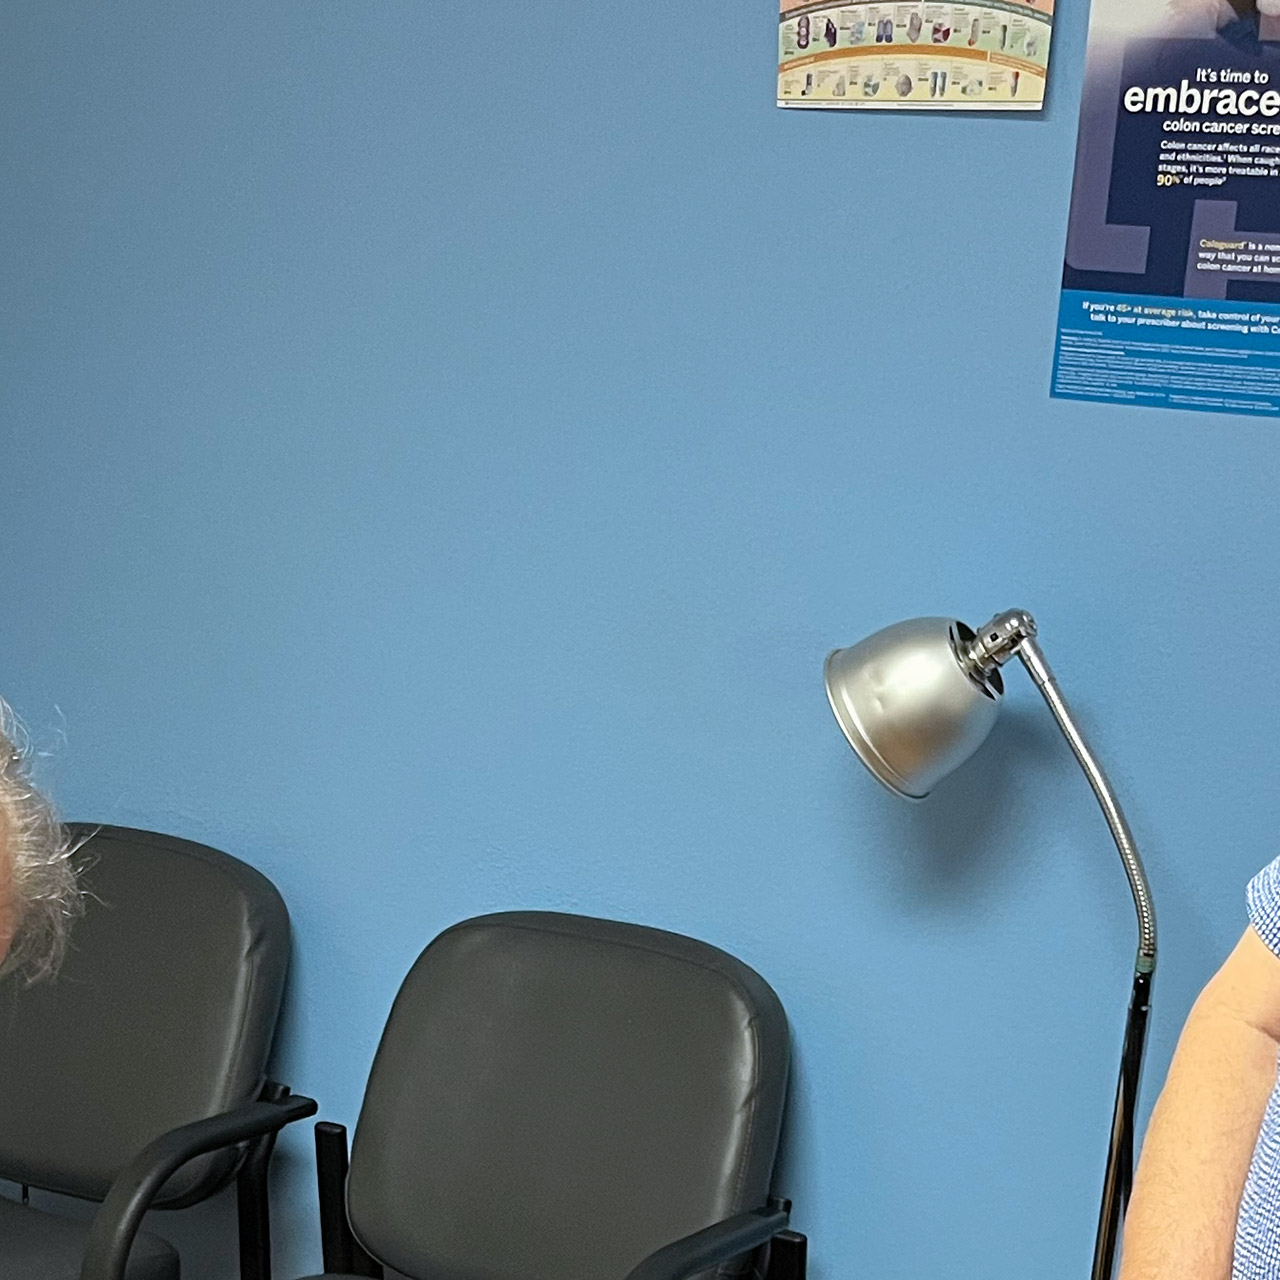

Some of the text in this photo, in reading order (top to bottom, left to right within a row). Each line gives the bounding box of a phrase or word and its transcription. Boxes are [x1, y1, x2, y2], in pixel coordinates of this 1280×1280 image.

[1196, 68, 1269, 83] It's time to
[1123, 79, 1280, 116] embrace
[1162, 118, 1200, 132] colon
[1202, 121, 1249, 135] cancer
[1160, 140, 1186, 150] Colon
[1186, 142, 1216, 151] cancer
[1217, 142, 1248, 153] affects
[1249, 144, 1260, 153] all
[1159, 152, 1176, 161] and
[1227, 154, 1253, 164] When
[1205, 166, 1227, 174] more
[1270, 168, 1278, 176] in
[1198, 252, 1216, 261] way
[1217, 252, 1235, 261] that
[1236, 254, 1253, 264] you
[1197, 262, 1221, 271] colon
[1222, 263, 1251, 273] cancer
